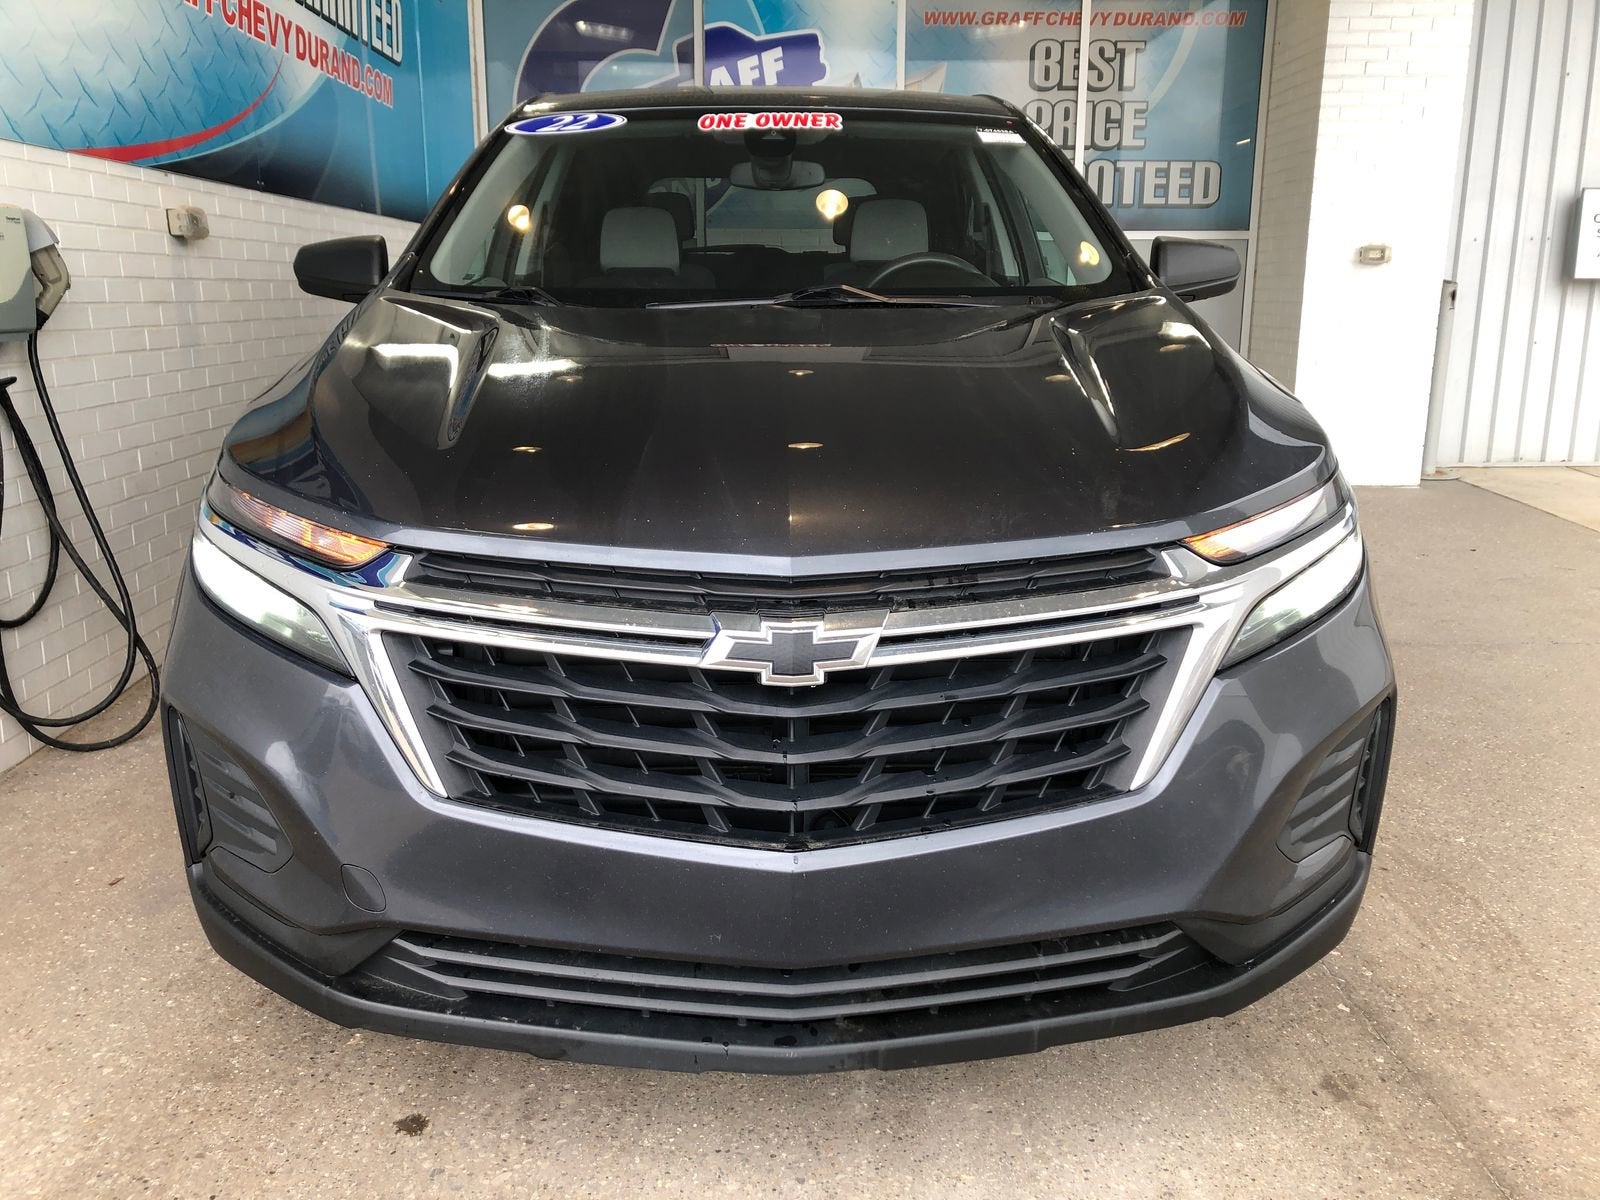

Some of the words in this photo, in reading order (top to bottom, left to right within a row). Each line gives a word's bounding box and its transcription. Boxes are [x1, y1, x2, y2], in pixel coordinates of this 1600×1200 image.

[184, 0, 393, 108] CHEVYDURAND.COM
[709, 46, 784, 86] AFF
[1029, 38, 1147, 92] BEST
[535, 113, 598, 132] 22
[700, 114, 747, 129] ONE
[755, 113, 842, 128] OWNER
[1085, 159, 1222, 208] NTEED
